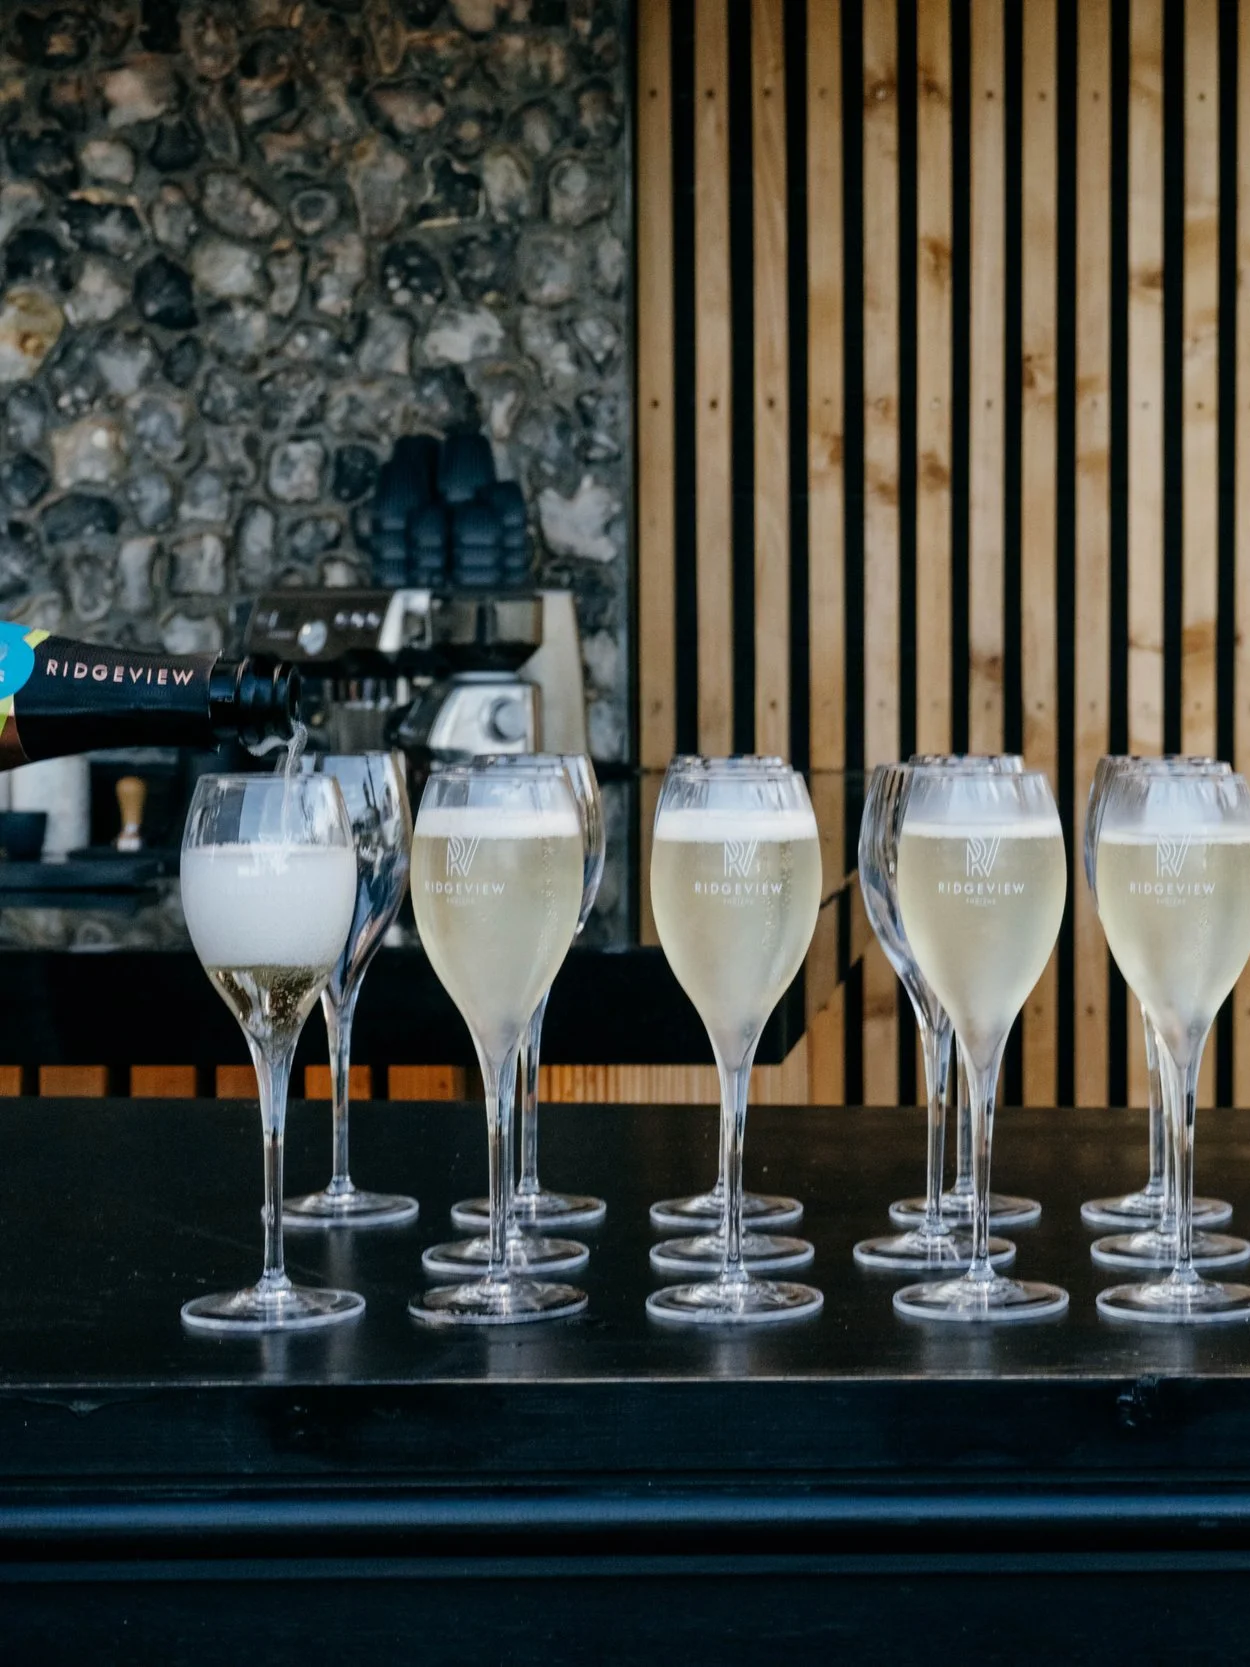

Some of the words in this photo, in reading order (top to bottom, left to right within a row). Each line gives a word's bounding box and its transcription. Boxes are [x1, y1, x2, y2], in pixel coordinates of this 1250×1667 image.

[46, 659, 194, 686] RIDGEVIEW
[425, 881, 505, 895] RIDGEVIEW
[695, 881, 782, 895] RIDGEVIEW
[938, 882, 1025, 895] RIDGEVIEW
[1129, 882, 1215, 895] RIDGEVIEW
